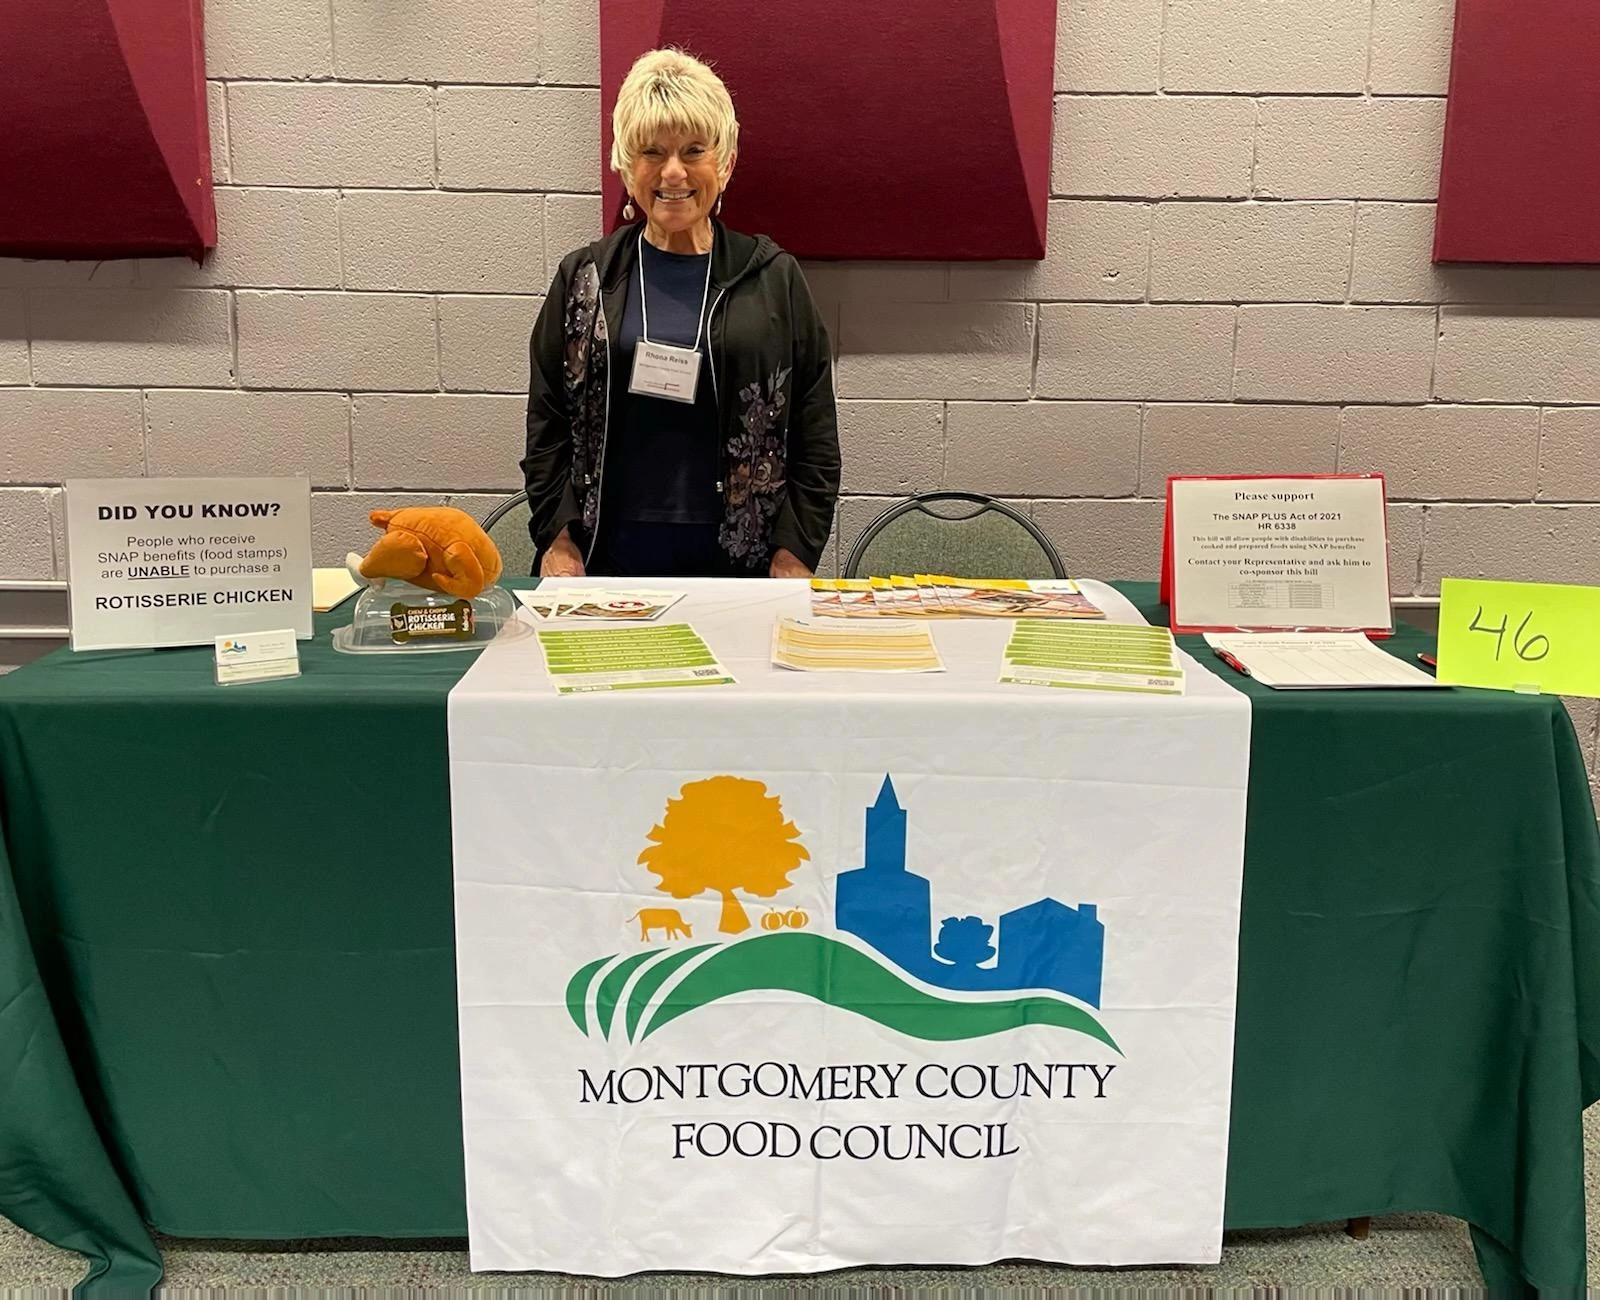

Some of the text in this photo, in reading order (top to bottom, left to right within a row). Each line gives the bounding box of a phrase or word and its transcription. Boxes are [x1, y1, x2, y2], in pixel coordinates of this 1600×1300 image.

[1235, 492, 1314, 502] Please support
[98, 503, 281, 520] DID YOU KNOW?
[1213, 513, 1342, 521] The SNAP PLUS Act of 2021
[1274, 522, 1296, 530] 6338
[127, 533, 256, 549] People who receive
[1251, 535, 1273, 543] people
[98, 547, 288, 564] SNAP benefits (food stamps)
[1221, 559, 1242, 567] your
[1244, 558, 1306, 567] Representative
[1308, 558, 1325, 566] and
[1343, 558, 1360, 566] him
[101, 563, 281, 579] are UNABLE to purchase a
[1239, 568, 1318, 577] co-sponsor this bill
[95, 589, 293, 610] ROTISSERIE CHICKEN
[408, 613, 455, 622] ROTISSERIE
[408, 622, 445, 630] CHICKEN
[1468, 605, 1550, 661] 46
[578, 1061, 1117, 1104] MONTGOMERY COUNTY
[671, 1121, 1020, 1161] FOOD COUNCIL
